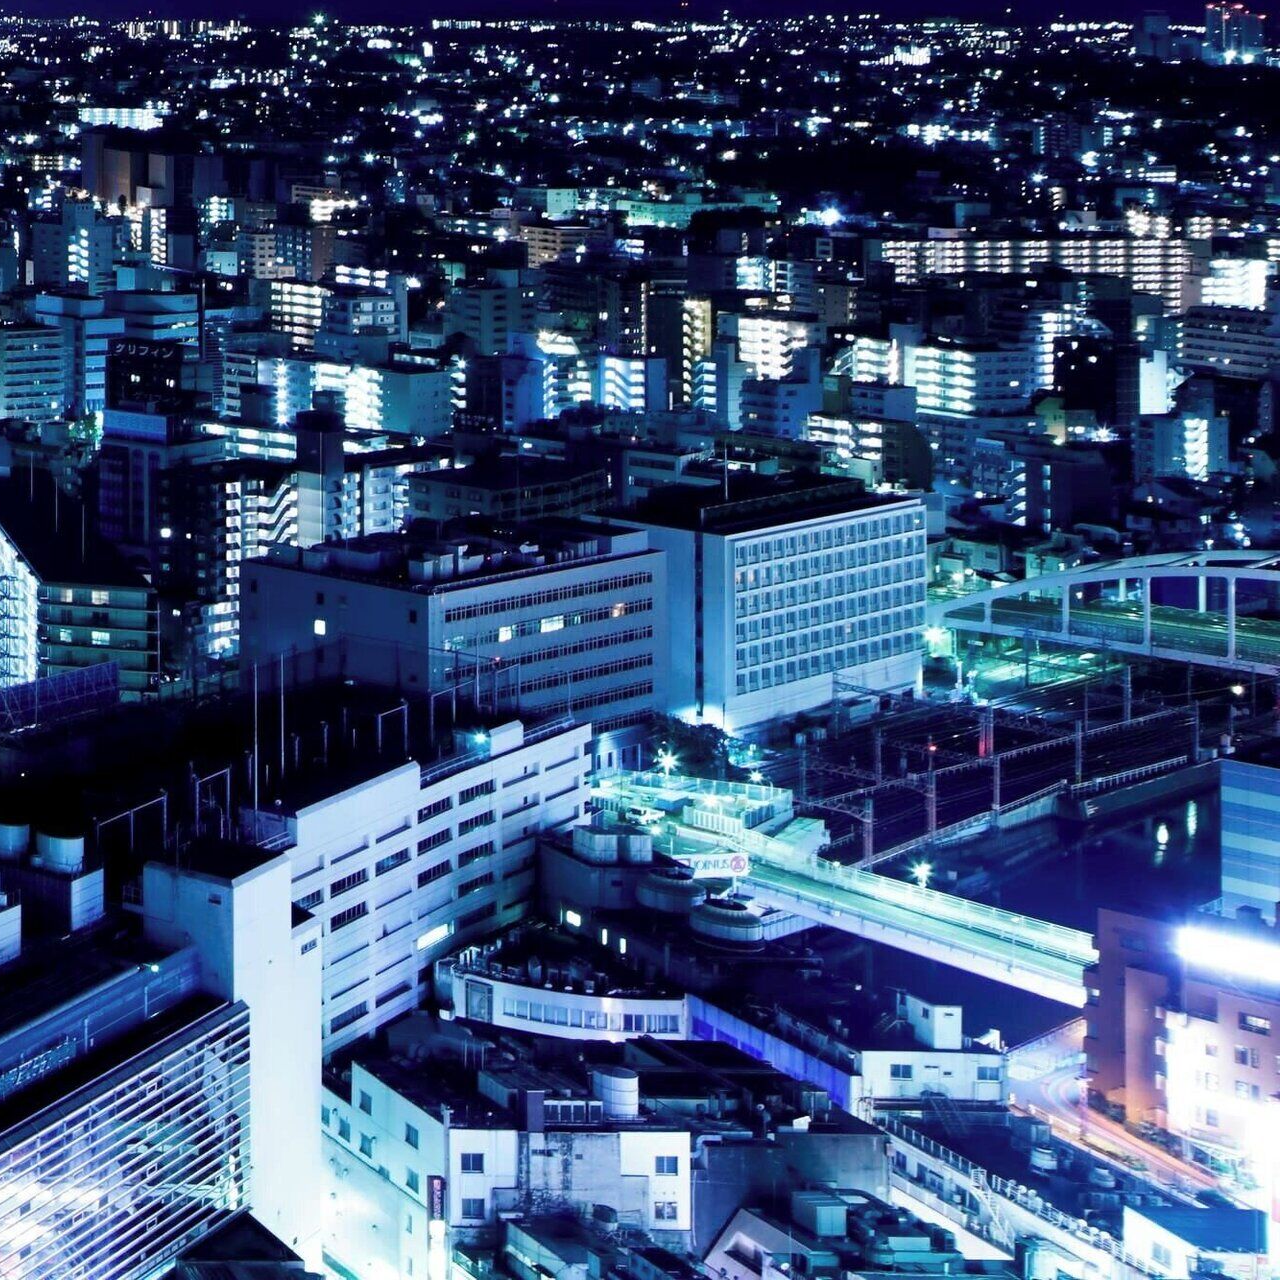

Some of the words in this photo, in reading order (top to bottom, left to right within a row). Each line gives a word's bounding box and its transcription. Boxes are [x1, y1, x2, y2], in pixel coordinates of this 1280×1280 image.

[116, 344, 174, 358] グリフィン
